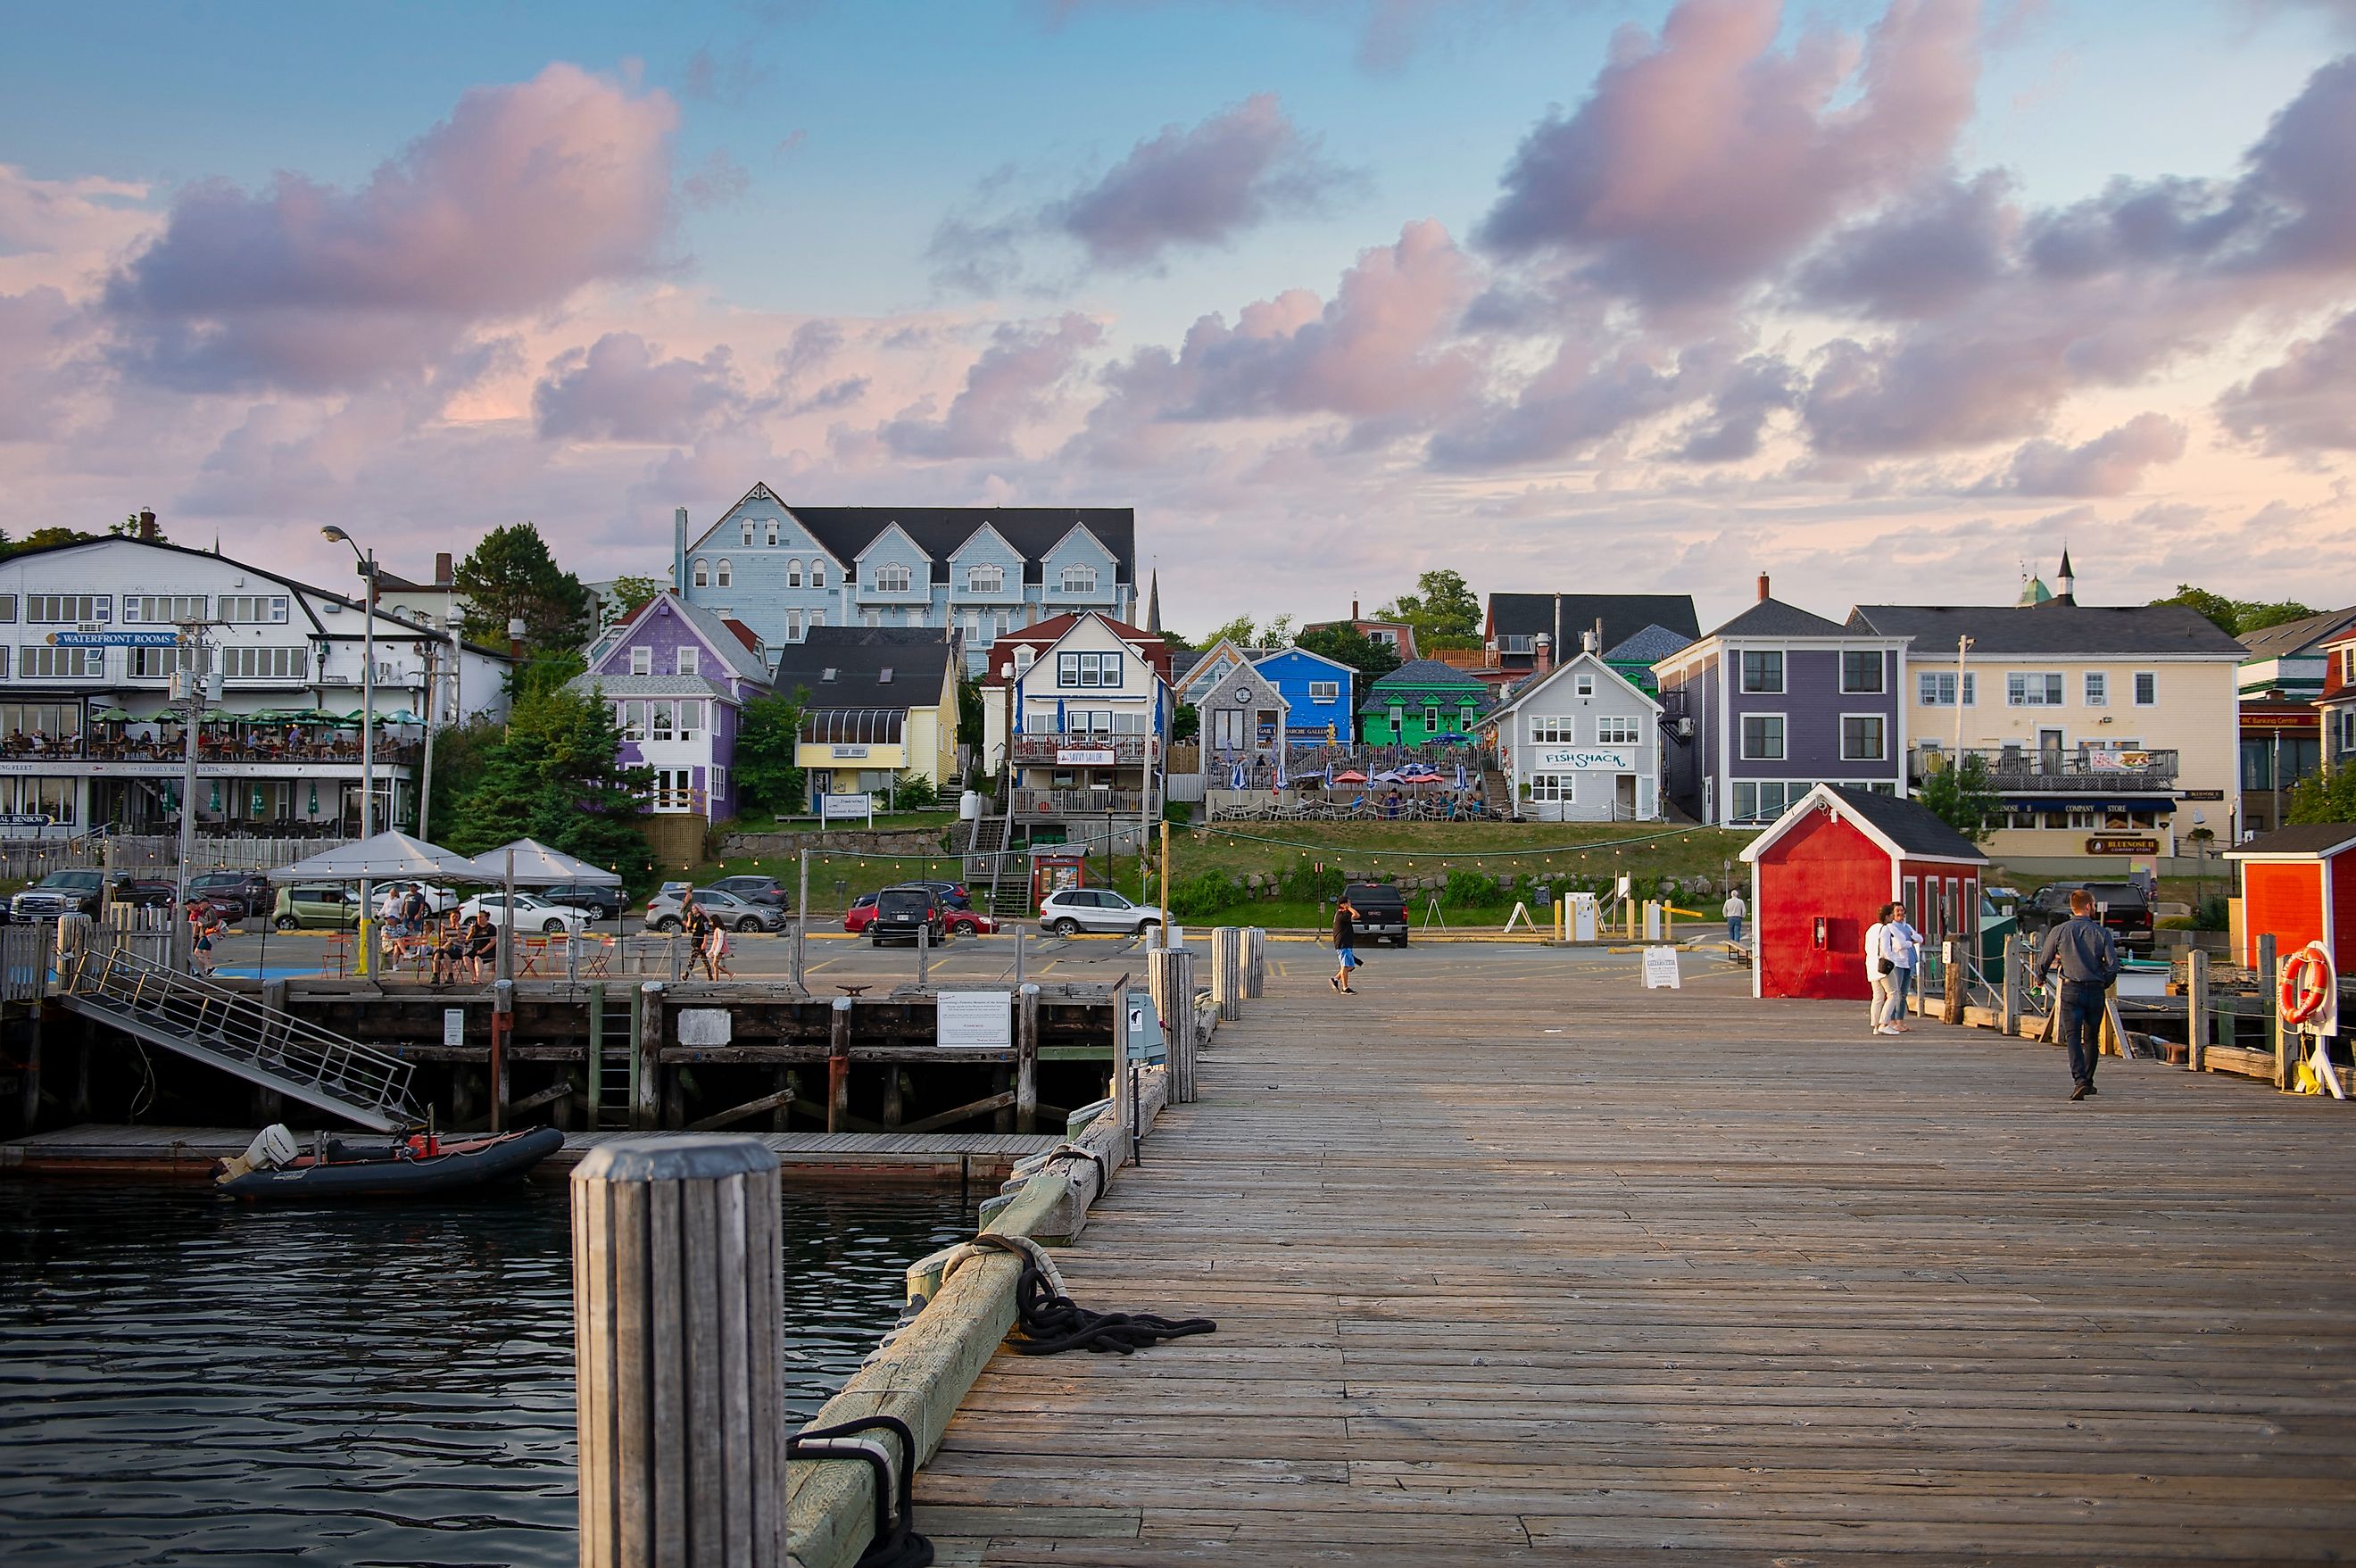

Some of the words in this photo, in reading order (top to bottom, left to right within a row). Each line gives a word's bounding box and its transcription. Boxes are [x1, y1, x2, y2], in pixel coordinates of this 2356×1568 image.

[63, 635, 131, 643] WATERFRONT
[135, 635, 170, 643] ROOMS
[2252, 717, 2277, 725] Banking
[1546, 754, 1574, 763] FISH
[1575, 753, 1626, 767] SHACK
[2065, 805, 2095, 813] COMPANY
[2107, 805, 2128, 813] STORE
